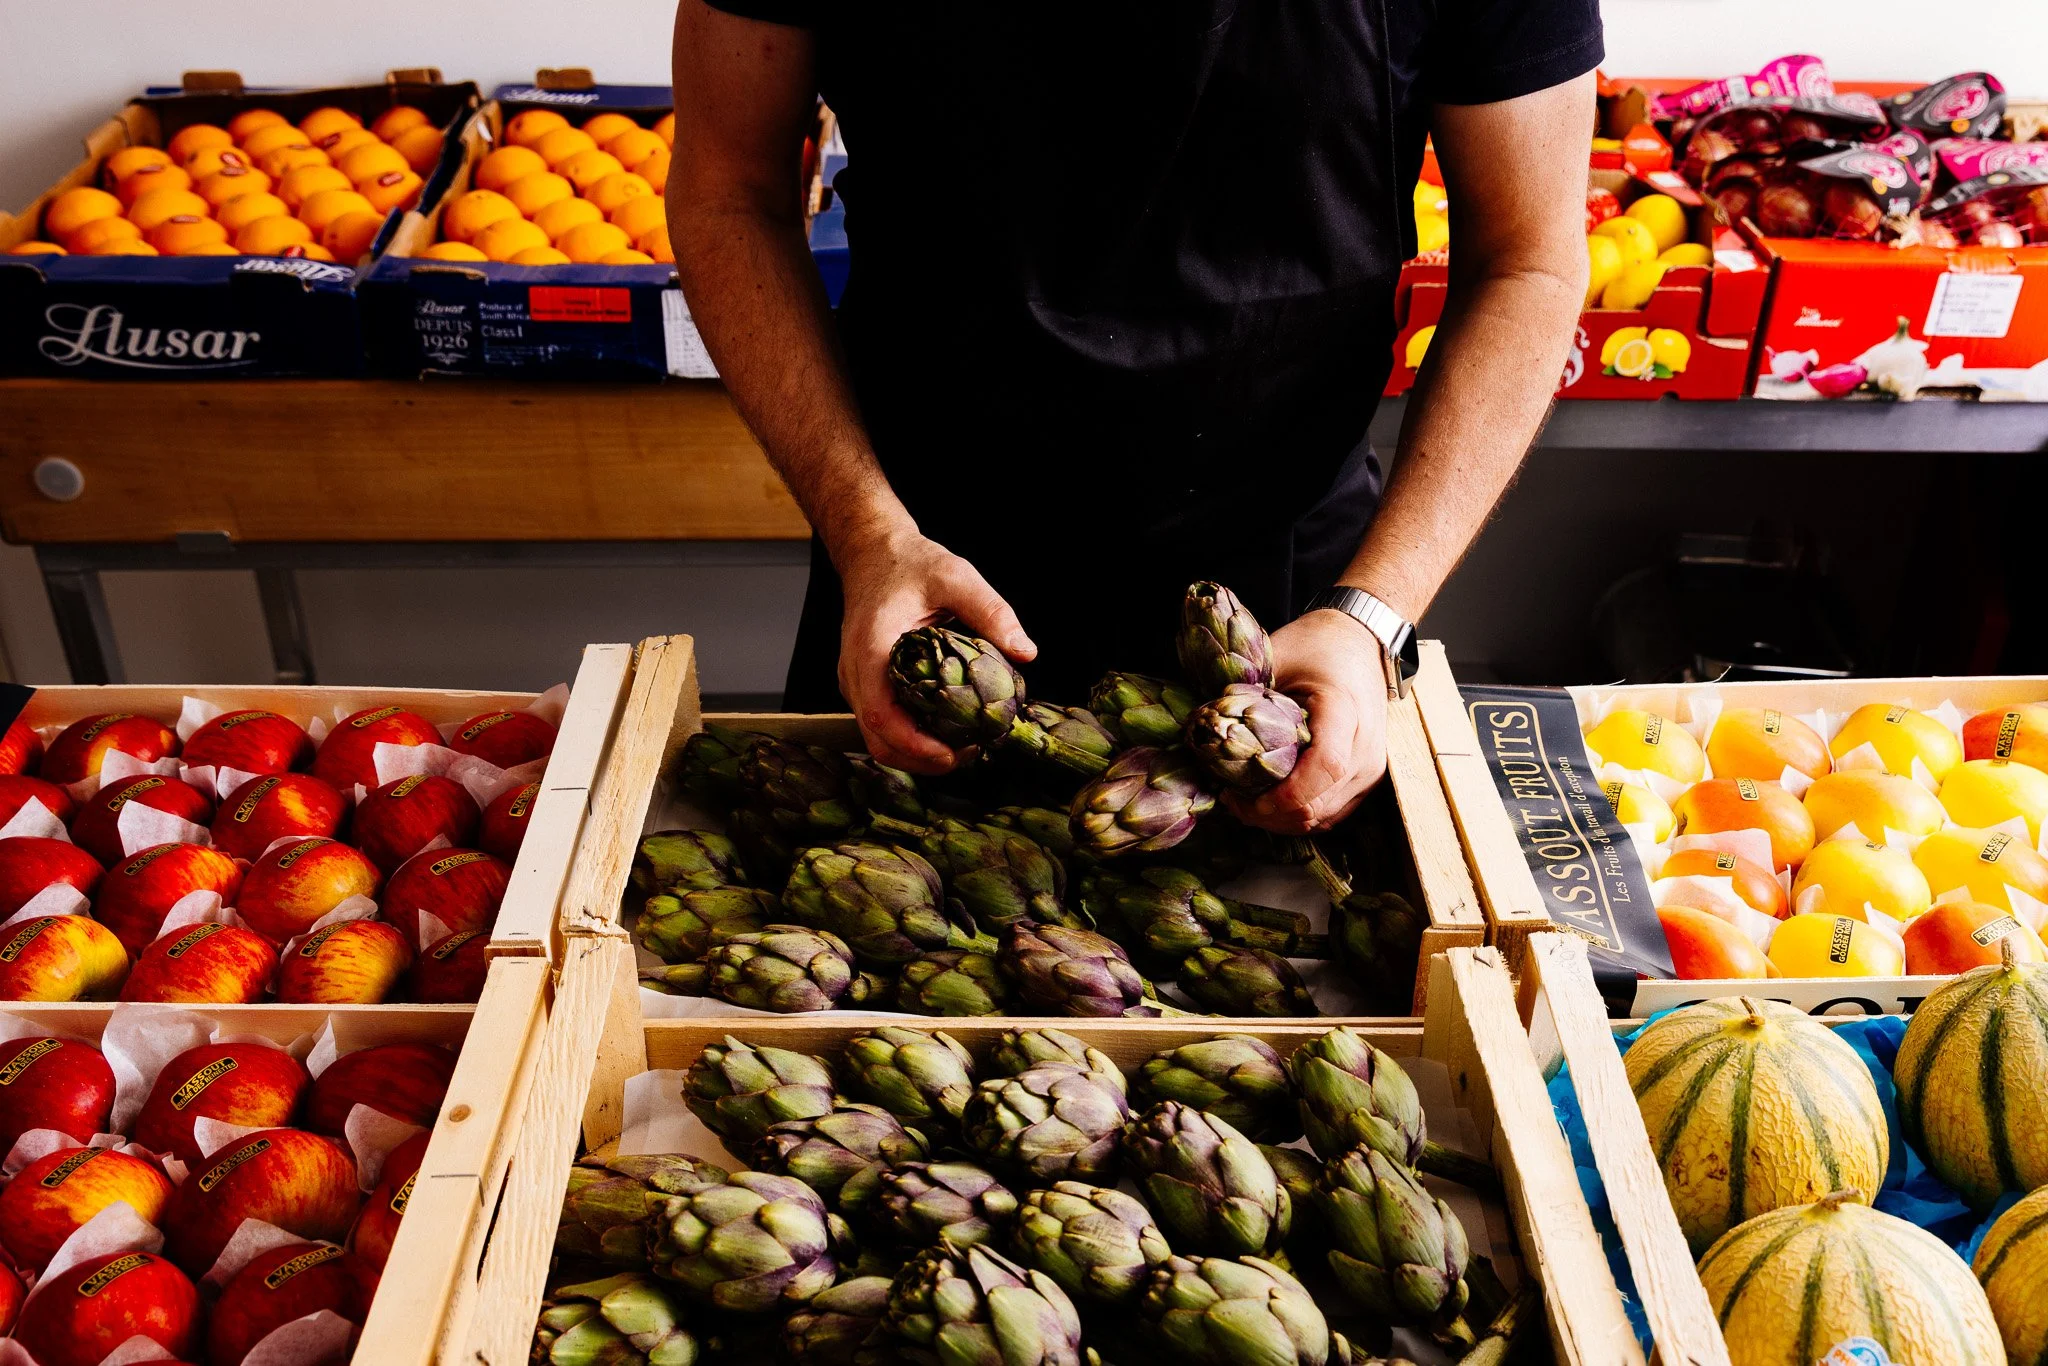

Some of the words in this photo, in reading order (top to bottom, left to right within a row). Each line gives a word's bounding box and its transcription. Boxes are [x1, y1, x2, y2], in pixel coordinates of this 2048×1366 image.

[39, 303, 260, 369] Llusar
[414, 318, 472, 332] DEPUIS
[481, 325, 515, 337] Class
[422, 334, 468, 348] 1926
[1997, 717, 2012, 749] VASSOUT
[2004, 731, 2014, 756] GOLDEN
[1489, 711, 1555, 801] FRUITS
[114, 780, 152, 802] VASSOUT
[1558, 756, 1587, 801] d'exception
[239, 782, 270, 812] VASSOUT
[1574, 803, 1600, 828] travail
[438, 855, 478, 866] VASSOUT
[1603, 845, 1624, 877] Fruits
[1612, 881, 1632, 903] Les
[6, 921, 45, 951] VASSOUT
[173, 925, 213, 949] VASSOUT
[1832, 920, 1846, 955] VASSOUT
[1839, 935, 1849, 962] GOLDEN
[2, 1041, 48, 1072] VASSOUT
[4, 1068, 19, 1082] REINE
[176, 1091, 193, 1107] REINE
[204, 1062, 236, 1083] REINETTES
[178, 1061, 224, 1095] VASSOUT
[49, 1151, 93, 1177] VASSOUT
[208, 1144, 259, 1177] VASSOUT
[205, 1173, 221, 1187] REINE
[87, 1255, 139, 1283] VASSOUT
[274, 1247, 328, 1275] VASSOUT
